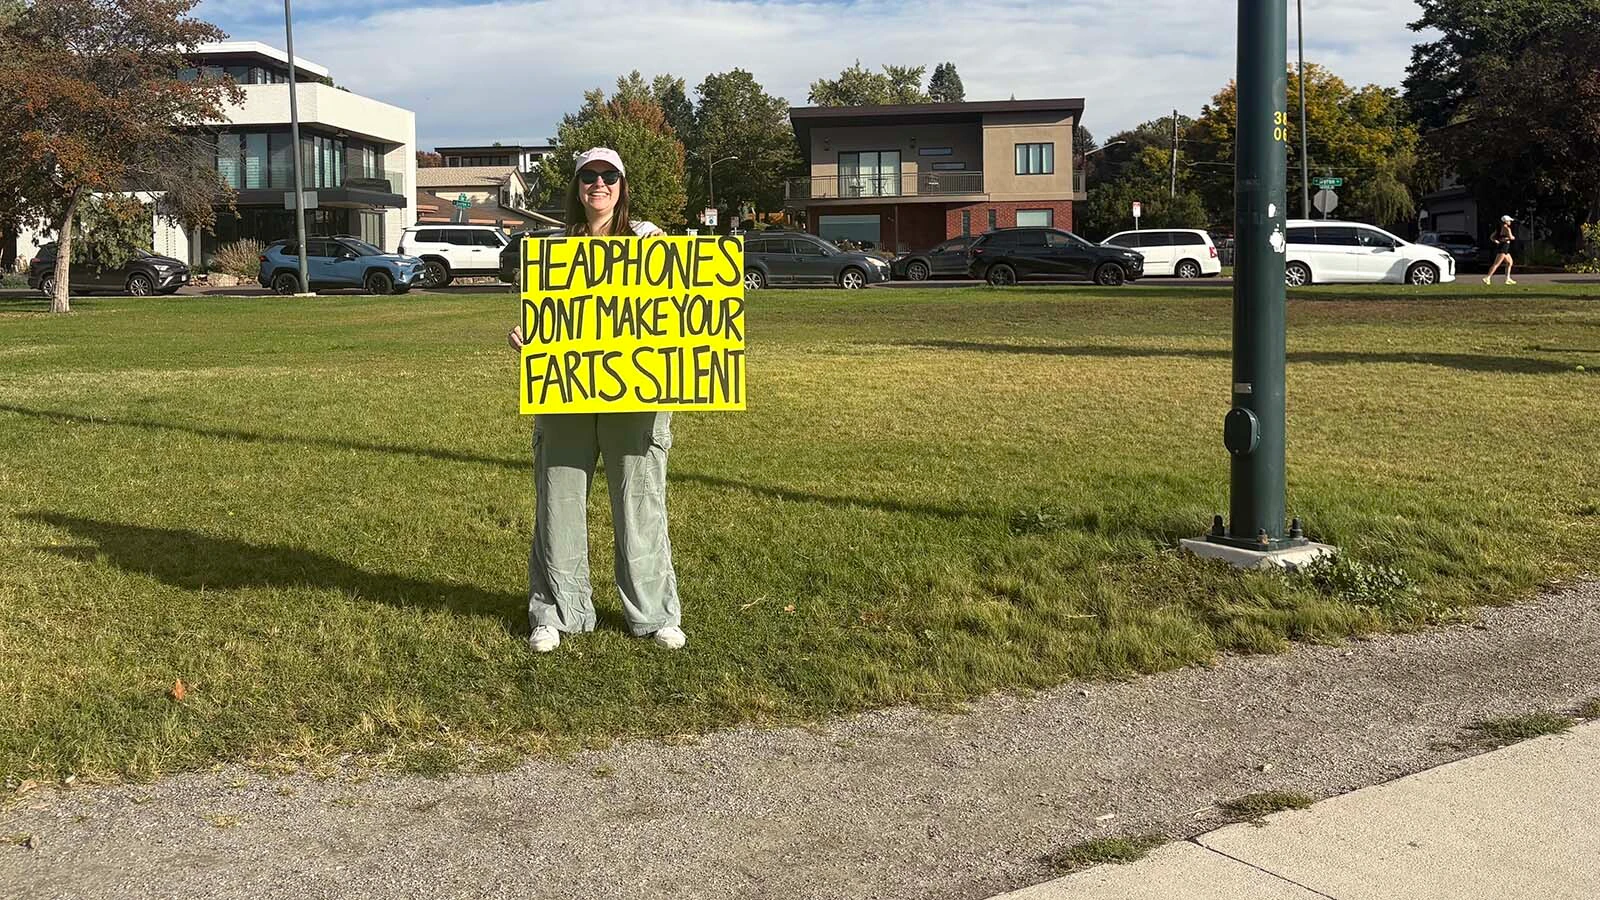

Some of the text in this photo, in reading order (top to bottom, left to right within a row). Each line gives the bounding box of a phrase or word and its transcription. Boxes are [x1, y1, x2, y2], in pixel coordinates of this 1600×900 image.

[522, 236, 743, 292] HEADPHONES
[522, 293, 744, 345] DONT MAKE YOUR
[525, 345, 744, 404] FARTS SILENT
